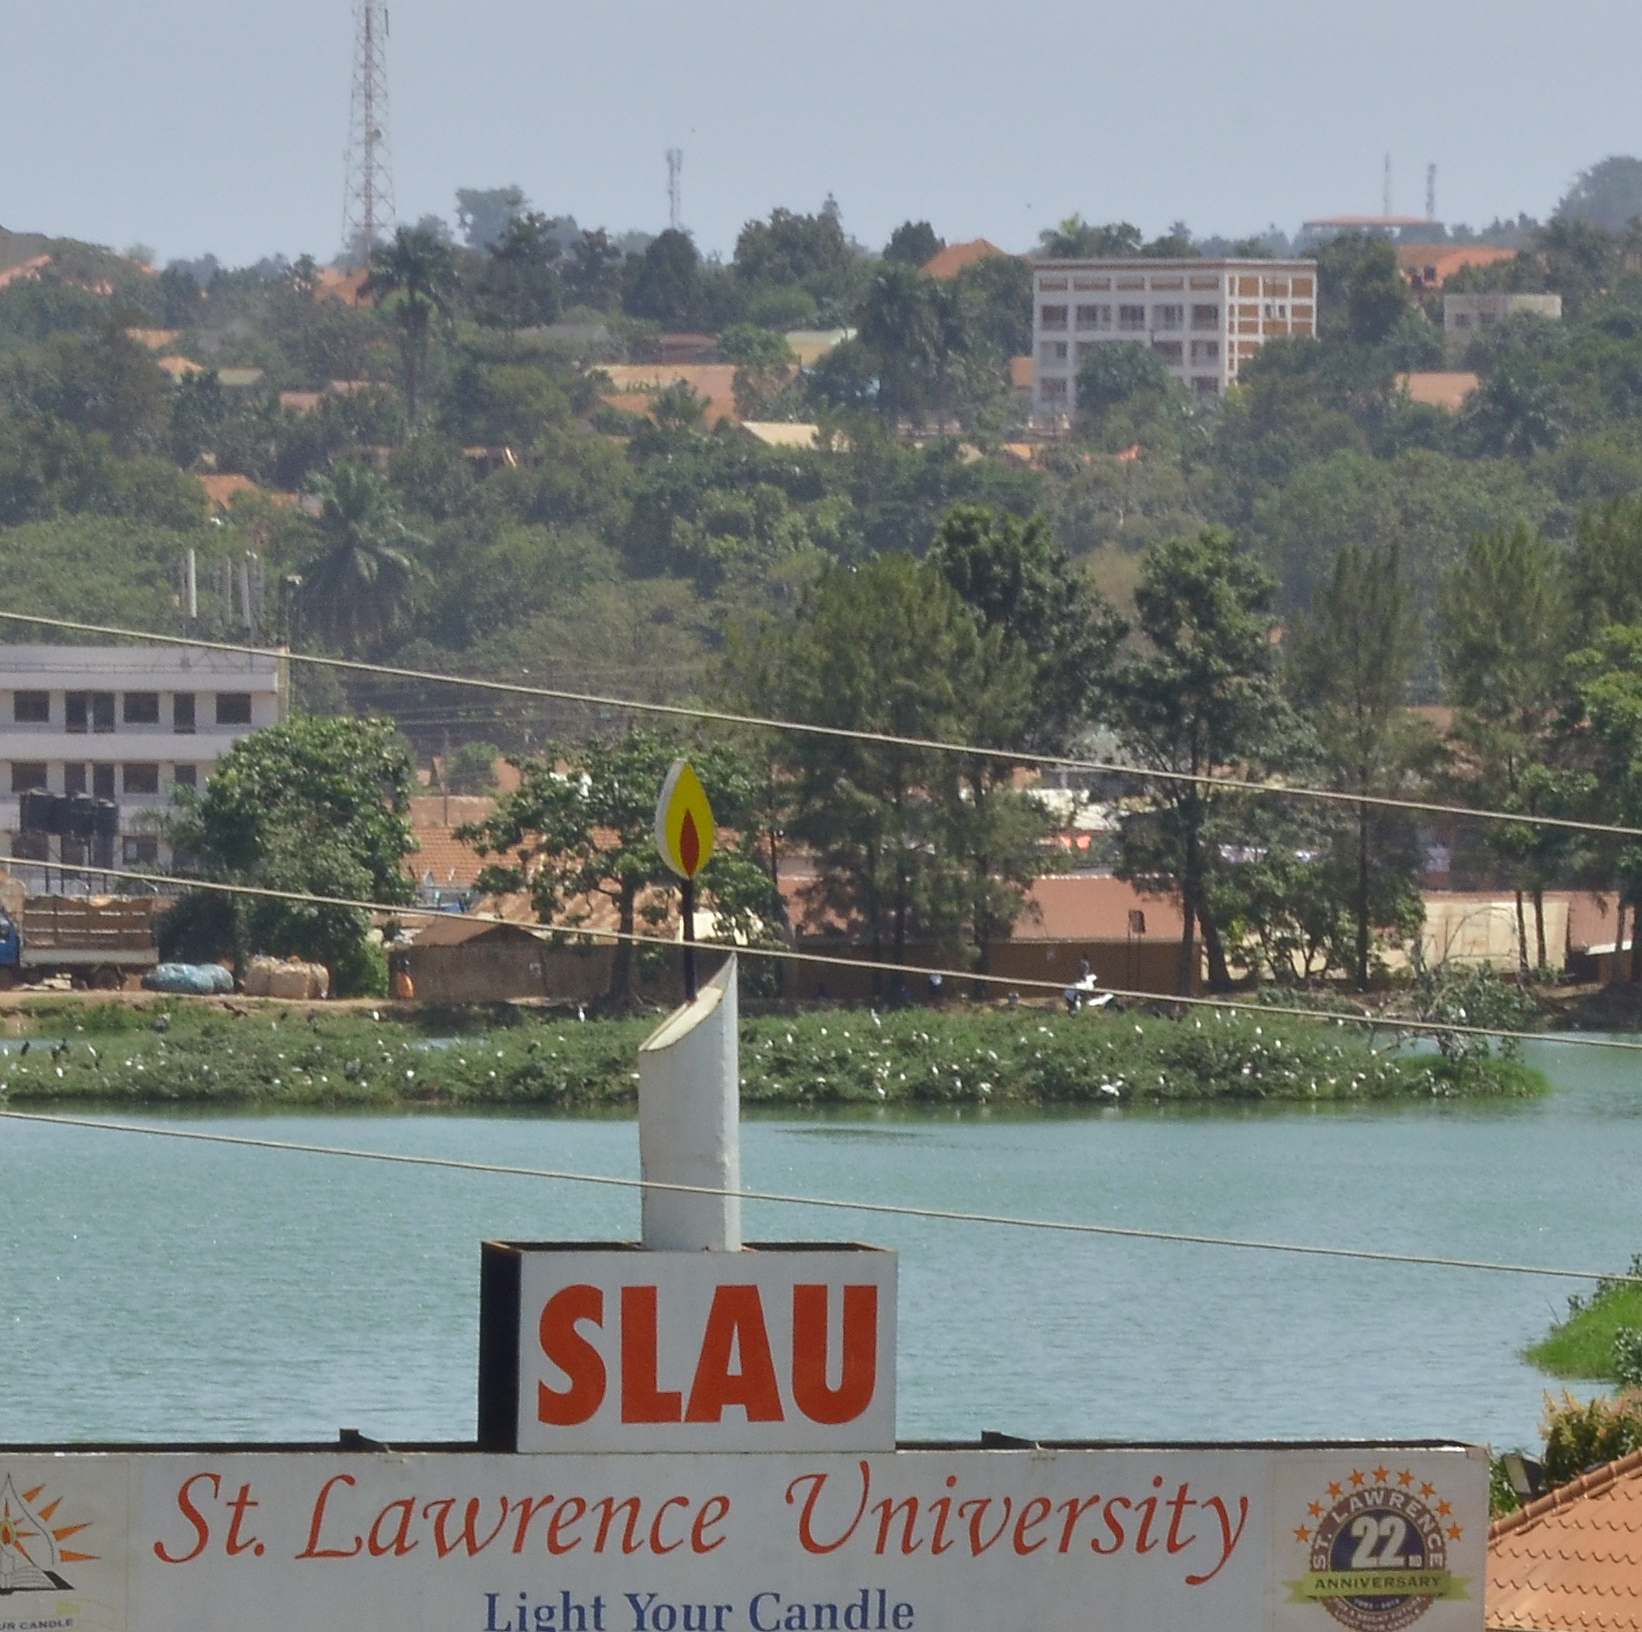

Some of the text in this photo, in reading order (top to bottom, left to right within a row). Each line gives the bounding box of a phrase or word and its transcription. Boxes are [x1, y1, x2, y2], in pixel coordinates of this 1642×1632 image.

[538, 1284, 878, 1426] SLAU
[153, 1461, 1249, 1586] St. Lawrence University
[1332, 1490, 1444, 1567] LAWRENCE
[623, 1592, 734, 1632] Your
[748, 1588, 915, 1632] Candle
[1314, 1575, 1442, 1590] ANNIVERSARY
[19, 1618, 74, 1631] CANDLE
